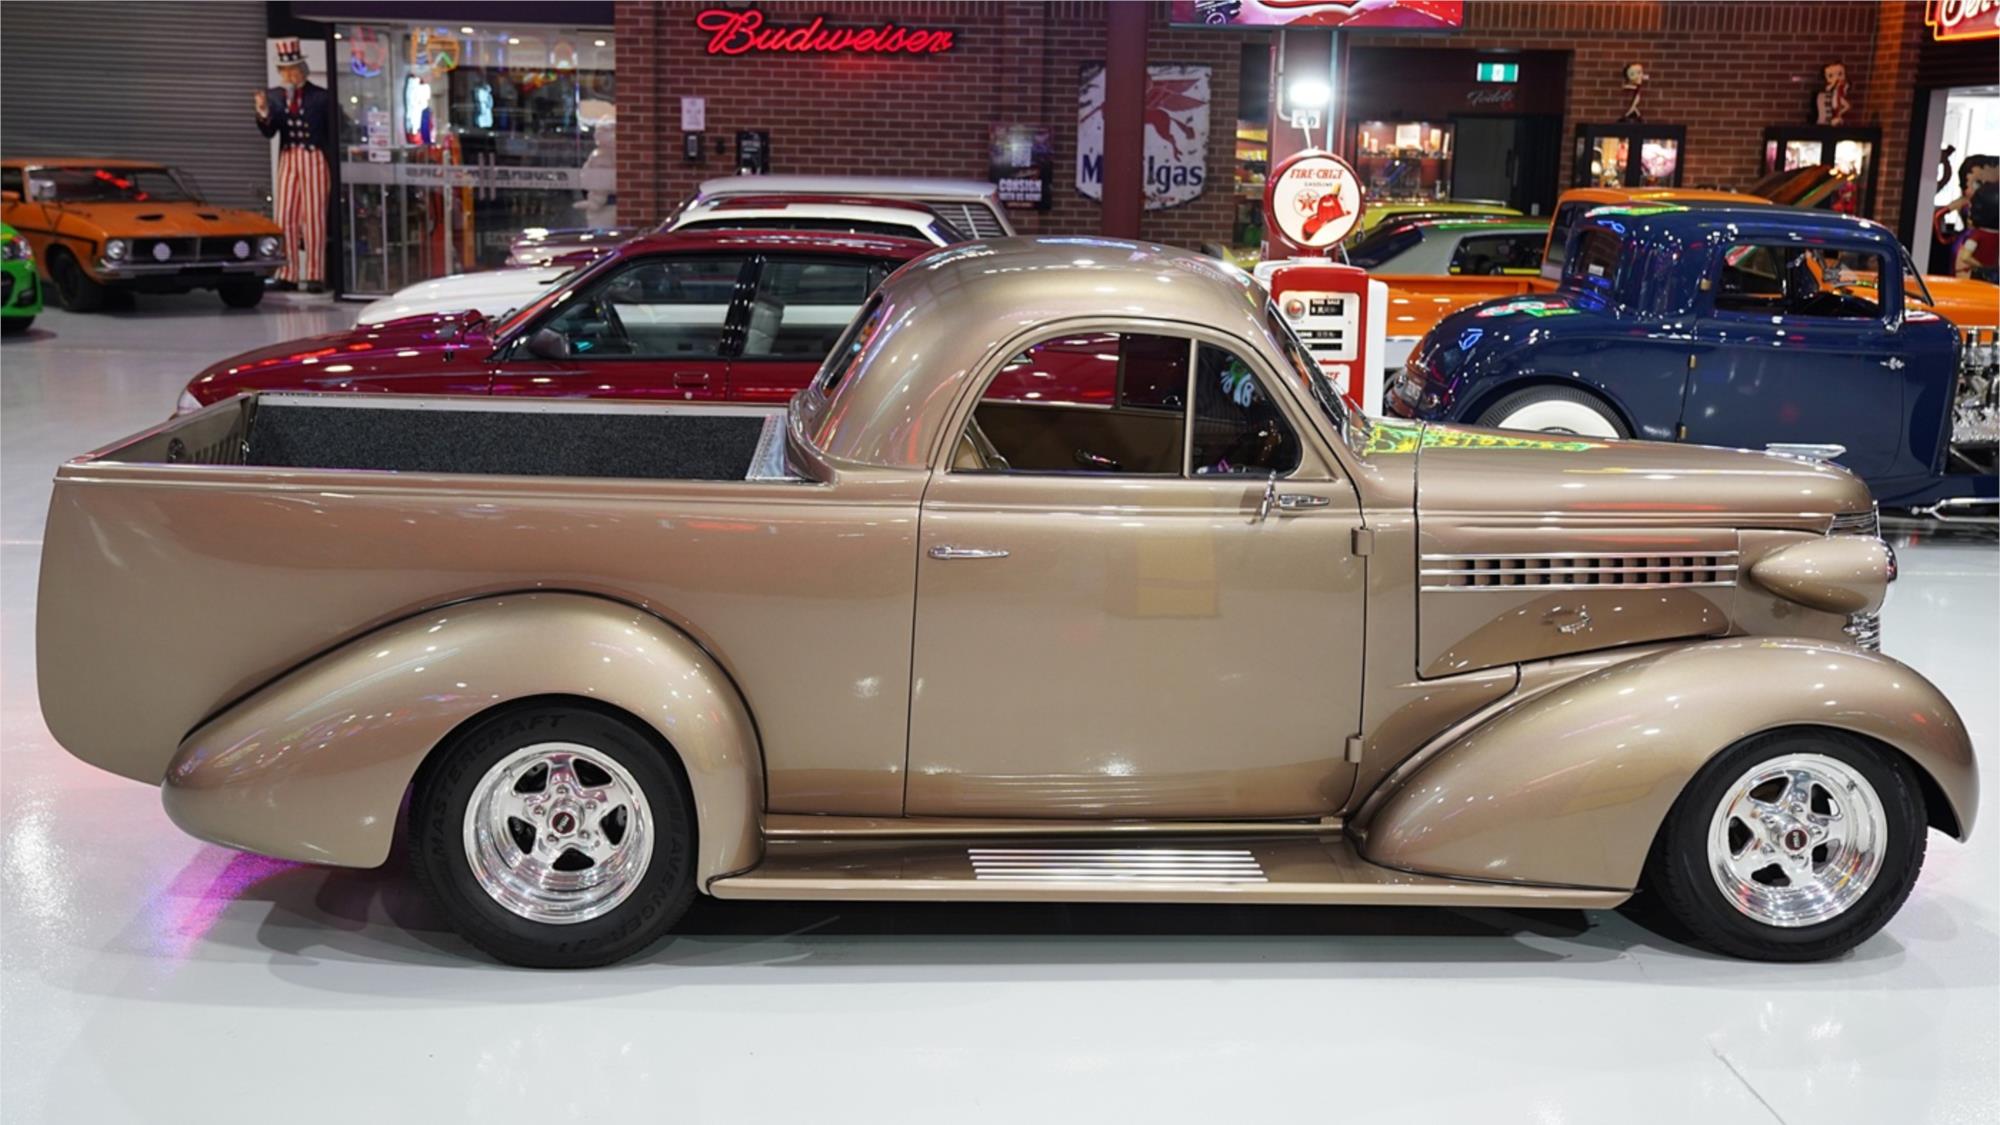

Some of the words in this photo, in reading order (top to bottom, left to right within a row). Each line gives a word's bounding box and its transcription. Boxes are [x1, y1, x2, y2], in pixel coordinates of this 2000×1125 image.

[696, 9, 953, 55] Budweiser
[999, 178, 1042, 192] CONSIGN
[1081, 153, 1203, 195] Mlgas
